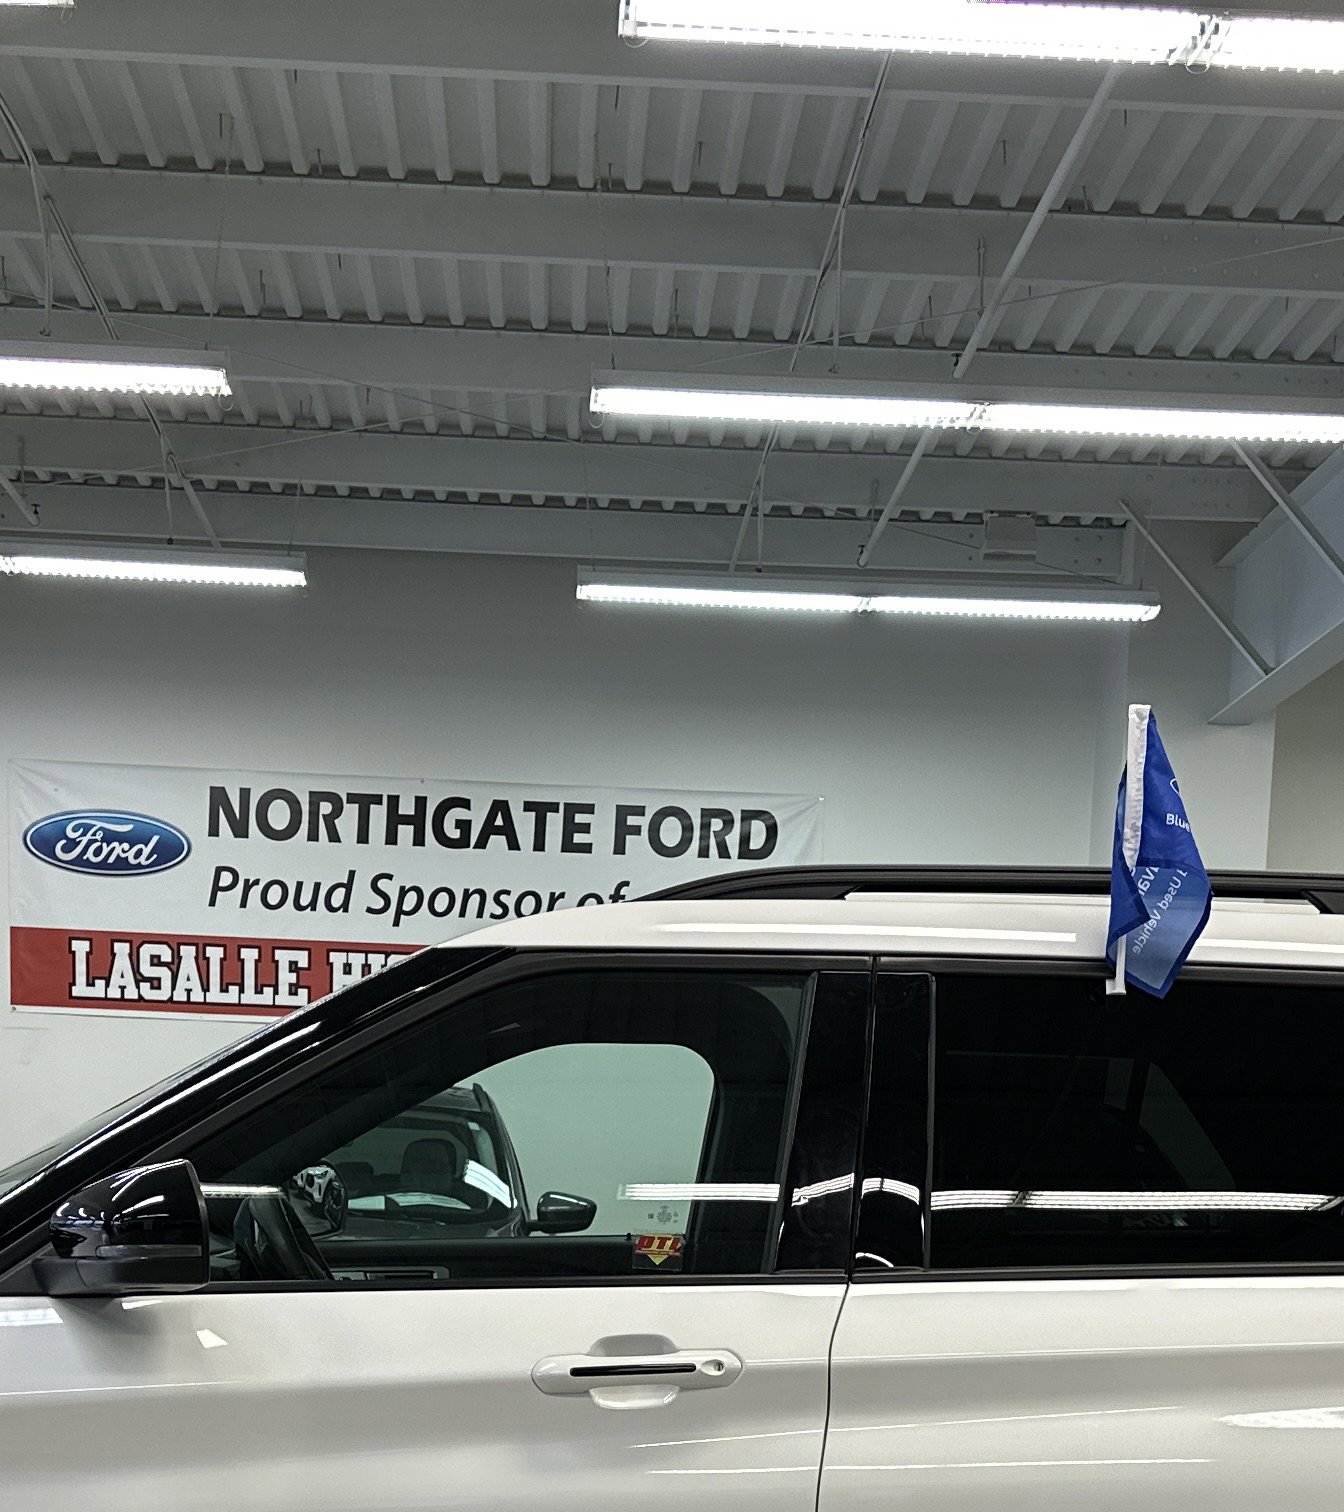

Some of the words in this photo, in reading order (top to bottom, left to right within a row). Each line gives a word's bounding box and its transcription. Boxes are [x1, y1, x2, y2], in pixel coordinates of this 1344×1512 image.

[52, 817, 162, 869] Ford
[206, 785, 596, 854] NORTHGATE
[612, 804, 779, 861] FORD
[208, 865, 357, 914] Proud
[365, 872, 566, 928] Sponsor
[69, 937, 312, 1008] LASALLE
